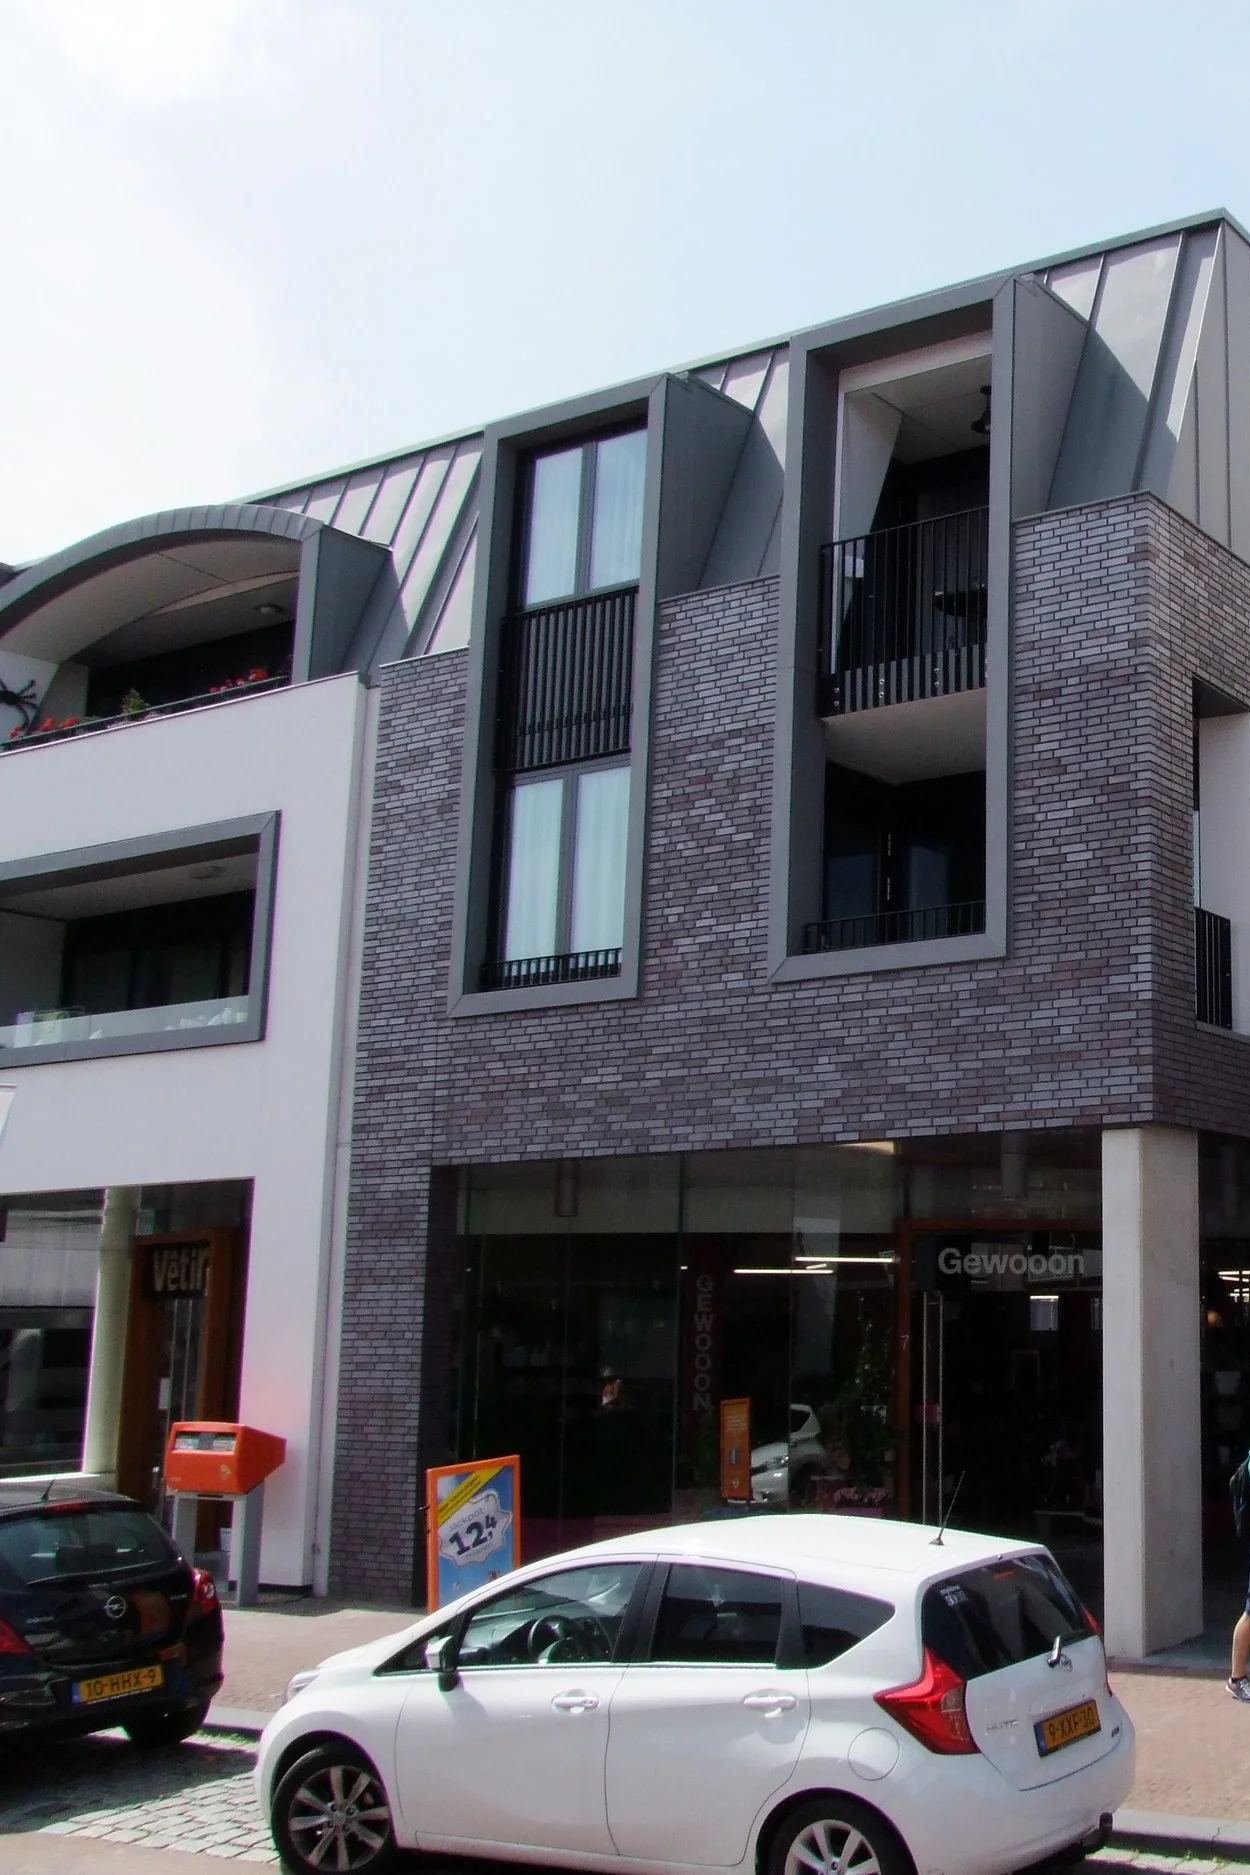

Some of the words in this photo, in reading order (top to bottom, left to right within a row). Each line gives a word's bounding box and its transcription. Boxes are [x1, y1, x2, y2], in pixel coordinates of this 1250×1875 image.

[937, 1247, 1085, 1275] Gewooon
[692, 1274, 716, 1410] GEWOOON
[448, 1507, 486, 1532] Jackpot
